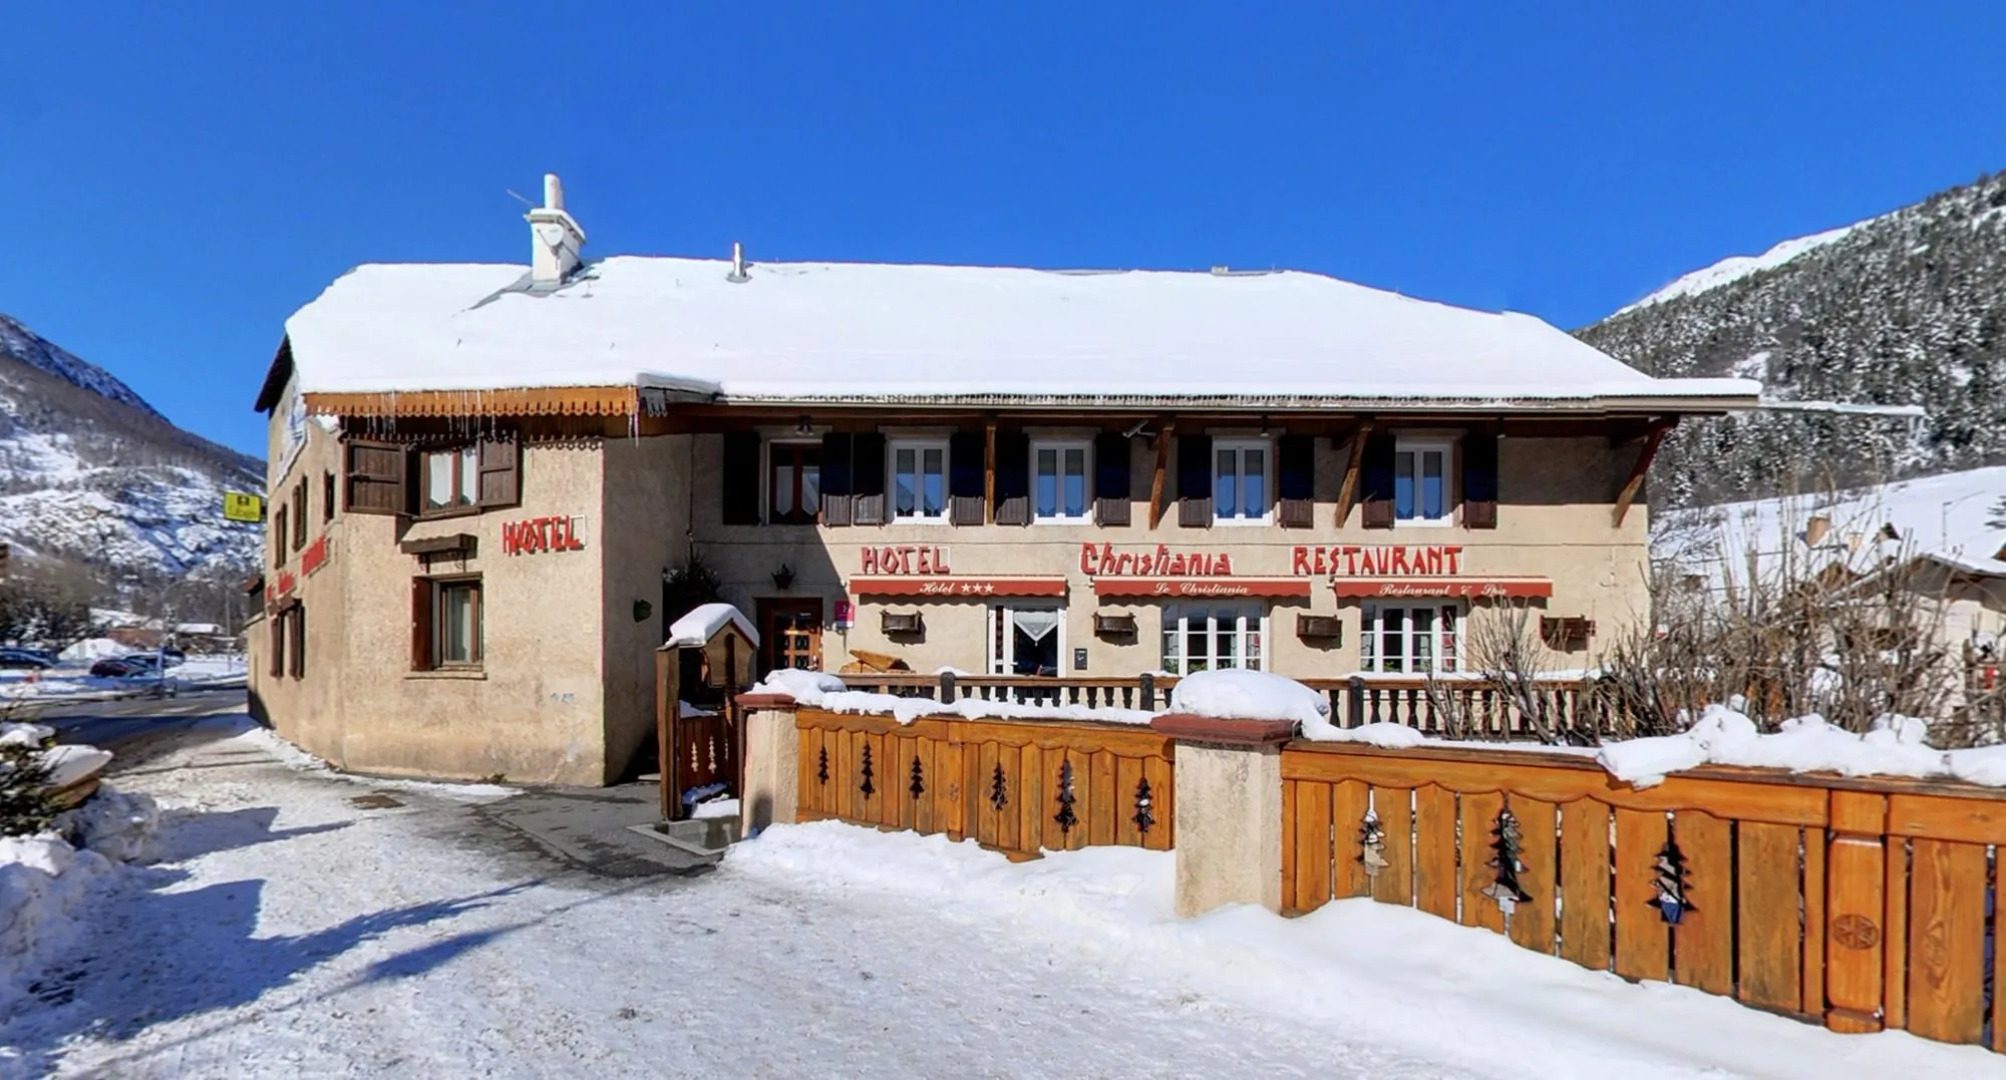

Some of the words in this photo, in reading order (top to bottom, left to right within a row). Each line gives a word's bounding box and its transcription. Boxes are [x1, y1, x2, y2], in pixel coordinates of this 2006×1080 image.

[502, 514, 582, 555] HOTEL
[861, 546, 949, 574] HOTEL
[1080, 541, 1232, 576] Christiania
[1294, 546, 1462, 575] RESTAURANT
[920, 582, 955, 593] Hotel
[1154, 583, 1170, 593] Le
[1181, 583, 1248, 594] Christiania
[1379, 584, 1451, 595] Restaurant
